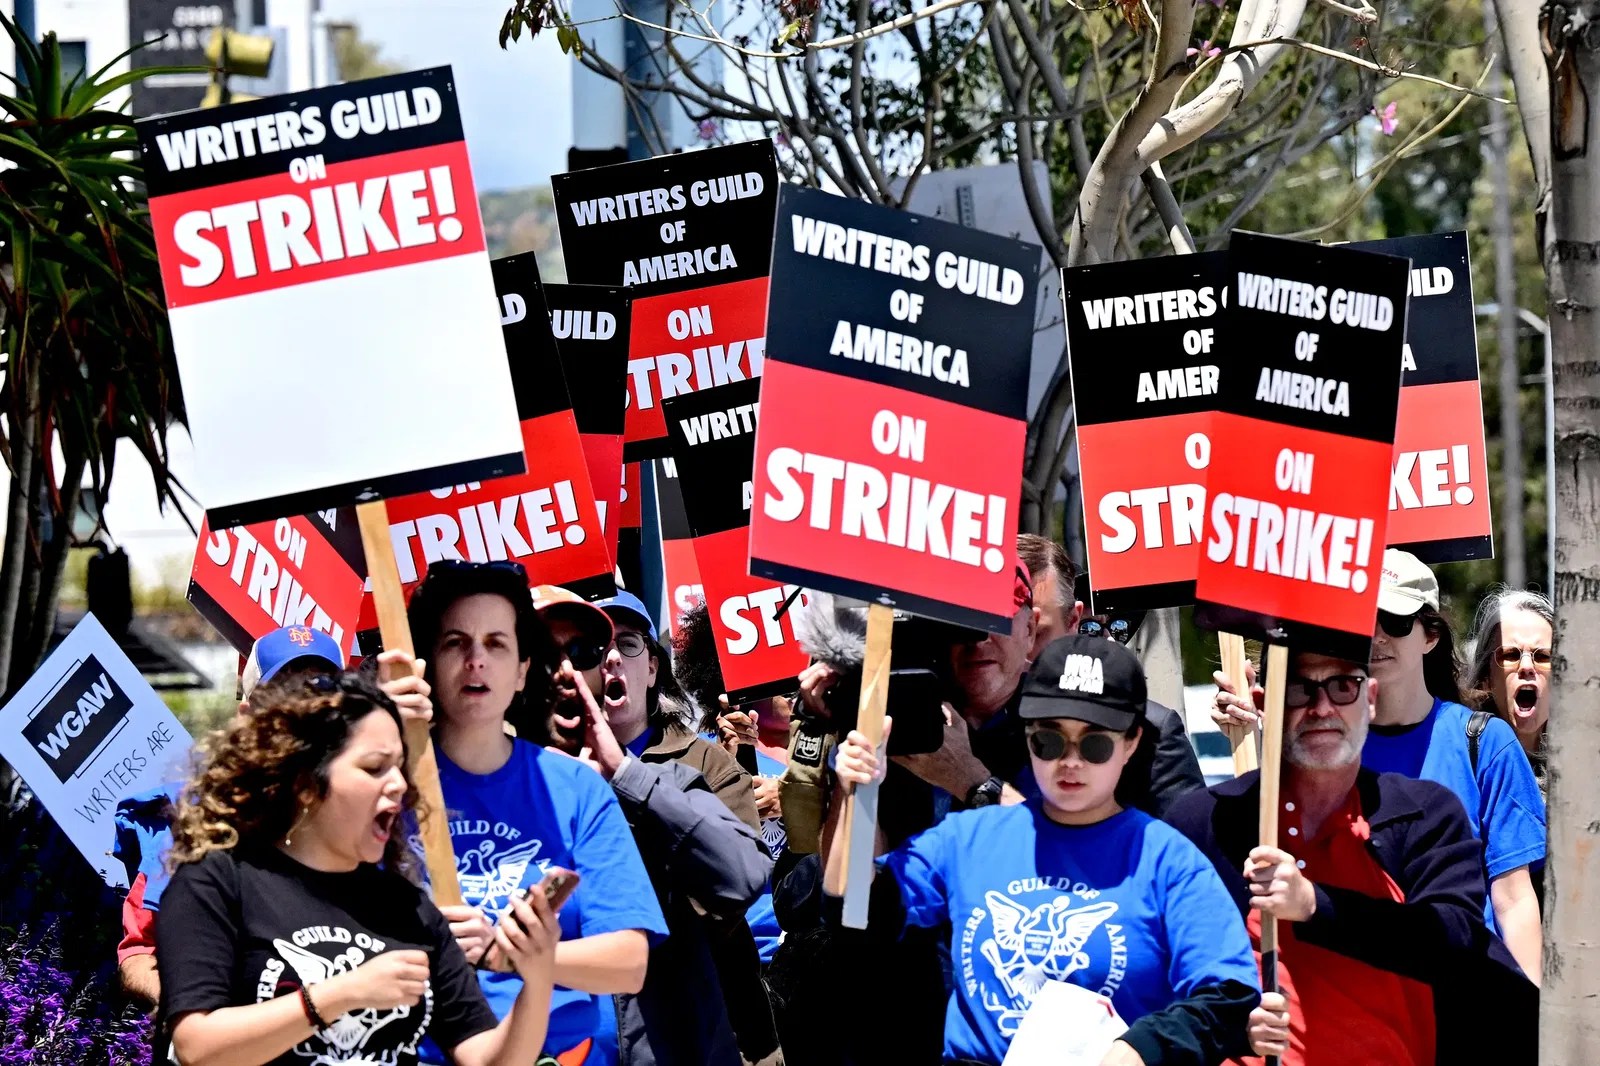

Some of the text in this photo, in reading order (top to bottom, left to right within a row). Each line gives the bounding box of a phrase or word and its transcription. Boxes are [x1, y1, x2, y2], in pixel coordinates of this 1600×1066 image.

[156, 87, 442, 171] WRITERS GUILD
[289, 154, 327, 183] ON
[570, 172, 764, 227] WRITERS GUILD
[173, 165, 464, 287] STRIKE!
[660, 220, 686, 244] OF
[623, 244, 738, 287] AMERICA
[791, 214, 1025, 306] WRITERS GUILD
[1407, 266, 1454, 298] ILD
[551, 309, 617, 341] UILD
[667, 304, 714, 341] ON
[890, 289, 924, 324] OF
[1082, 286, 1217, 330] WRITERS
[1237, 271, 1327, 321] WRITERS
[1329, 288, 1393, 332] GUILD
[829, 320, 970, 388] AMERICA
[1182, 328, 1214, 356] OF
[1295, 331, 1320, 362] OF
[627, 336, 766, 411] TRIKE
[1137, 364, 1220, 403] AMER
[1255, 367, 1350, 417] AMERICA
[679, 402, 760, 446] WRIT
[871, 409, 927, 463] ON
[1184, 432, 1211, 470] O
[1275, 448, 1315, 495] ON
[763, 446, 1007, 573] STRIKE!
[1098, 483, 1207, 554] STR
[274, 517, 308, 570] ON
[364, 480, 586, 592] TRIKE!
[1206, 492, 1375, 595] STRIKE!
[37, 672, 116, 761] WGAW
[74, 721, 175, 824] WRITERS ARE
[494, 822, 522, 841] OF
[1008, 876, 1101, 900] GUILD OF
[292, 926, 352, 947] GUILD
[961, 906, 987, 998] WRITERS
[1097, 923, 1128, 999] AMERIC
